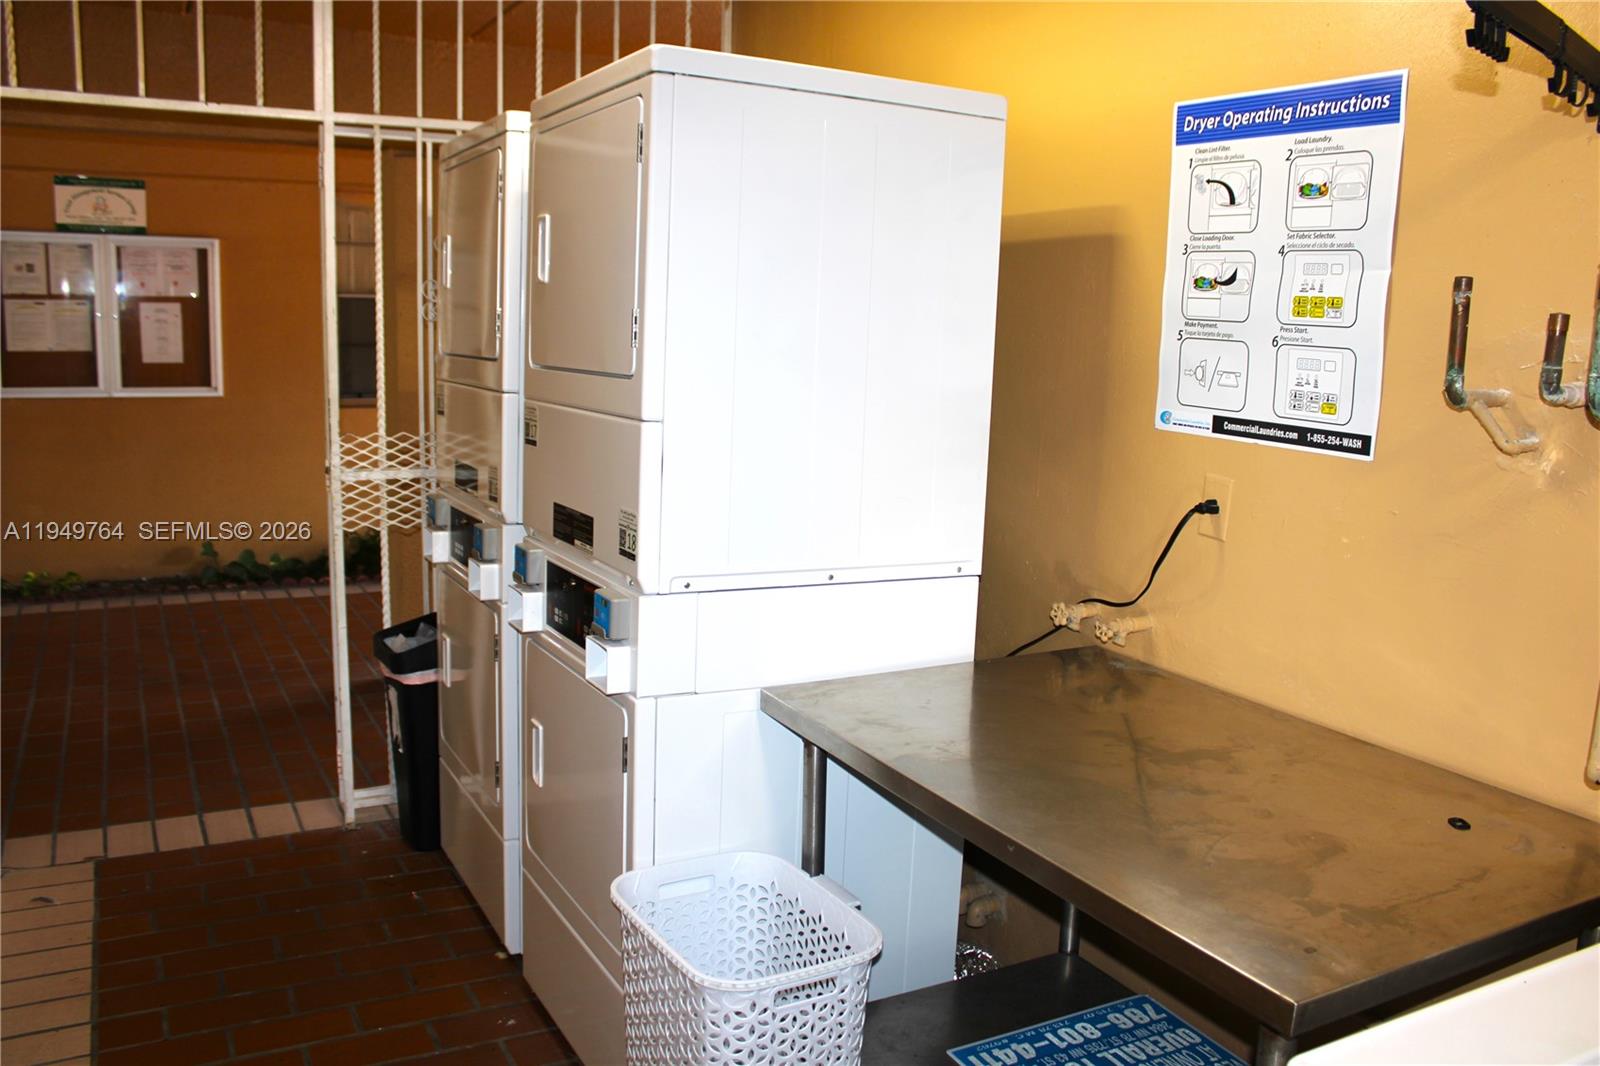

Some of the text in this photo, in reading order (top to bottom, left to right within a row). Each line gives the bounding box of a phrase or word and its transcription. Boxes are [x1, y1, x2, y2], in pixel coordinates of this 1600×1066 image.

[1184, 93, 1391, 134] Dryer Operating Instructions
[1294, 135, 1333, 145] Load Laundry.
[1195, 147, 1208, 155] Clean
[1285, 148, 1293, 161] 2
[1294, 147, 1314, 155] Coloque
[1189, 158, 1193, 169] 1
[1203, 234, 1221, 242] Loading
[1296, 232, 1312, 240] Fabric
[1313, 232, 1336, 240] Selector.
[1182, 243, 1188, 256] 3
[1278, 244, 1285, 257] 4
[1197, 321, 1218, 329] Payment.
[1280, 326, 1308, 334] Press Start.
[1177, 329, 1183, 341] 5
[1272, 335, 1279, 348] 6
[1280, 335, 1299, 343] Presione
[1223, 420, 1298, 440] CommercialLaundries.com
[1306, 432, 1362, 449] 1-855-254-WASH
[627, 532, 637, 552] 18
[967, 1003, 1167, 1066] 786-801-4411
[1096, 1028, 1202, 1066] OVERALL
[1195, 1043, 1221, 1062] AT
